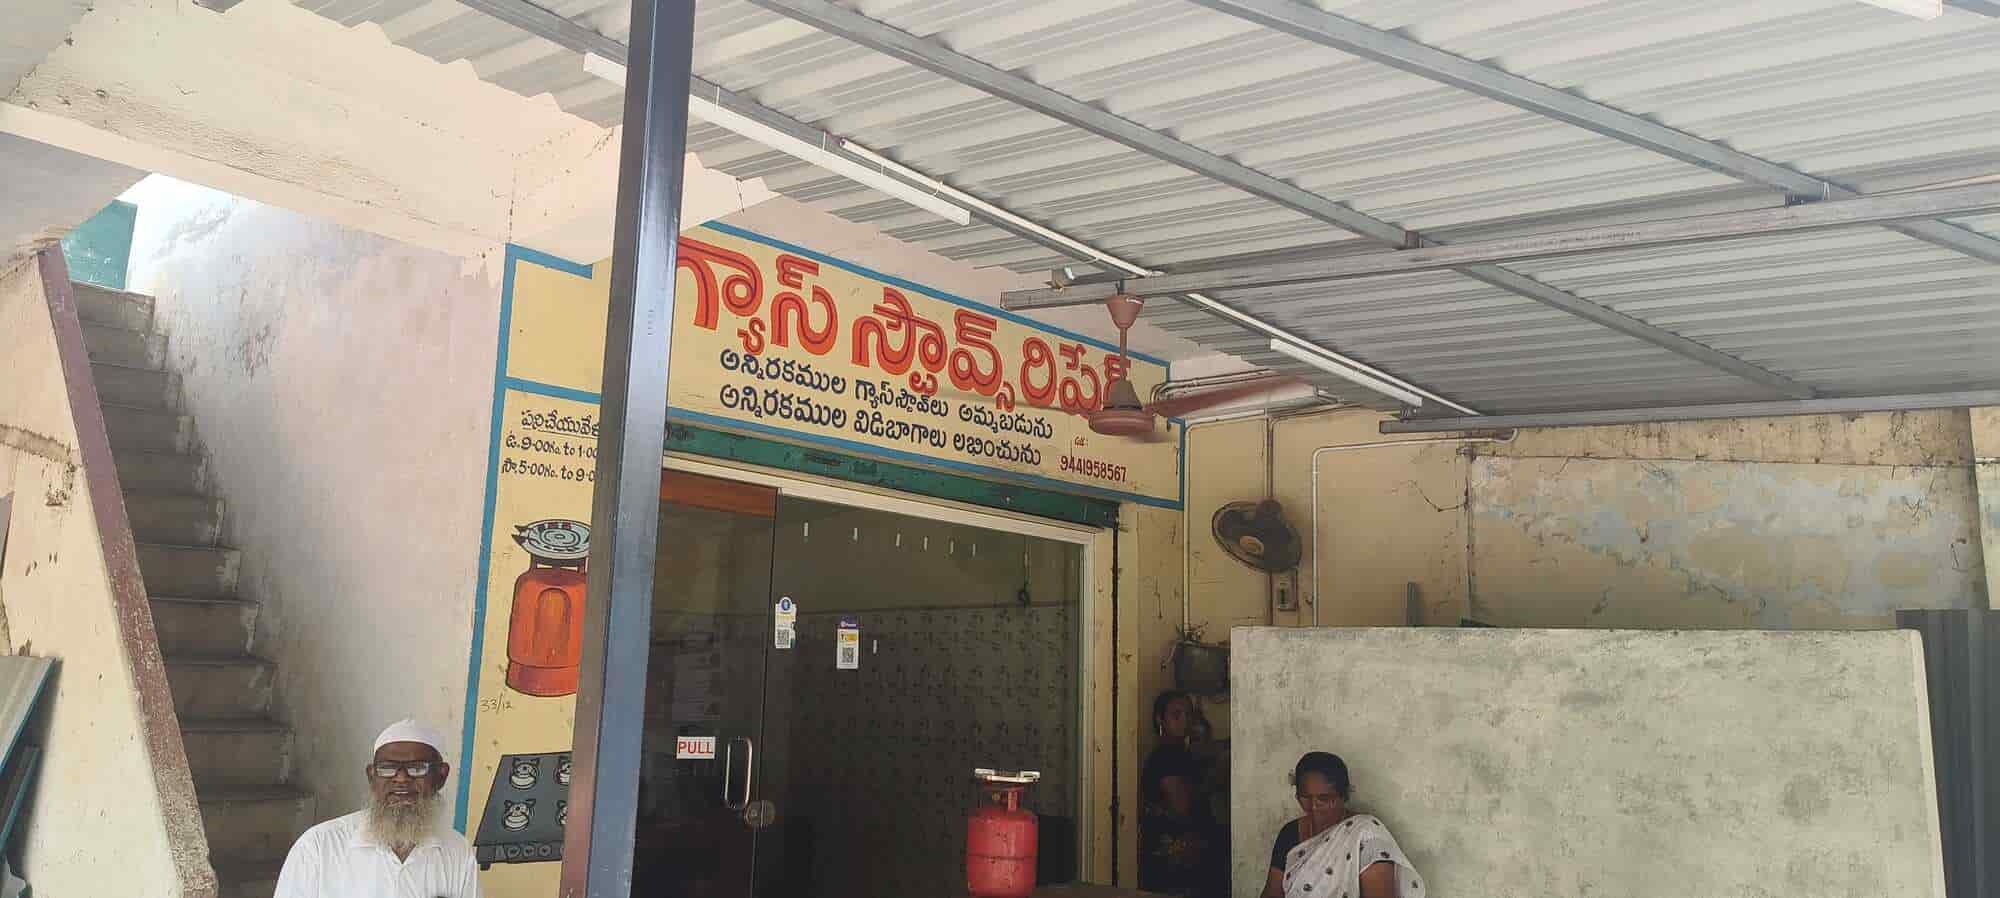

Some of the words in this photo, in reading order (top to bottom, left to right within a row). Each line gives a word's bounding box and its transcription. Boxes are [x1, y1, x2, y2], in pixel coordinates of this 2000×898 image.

[563, 442, 576, 456] to
[560, 465, 574, 480] to
[1060, 455, 1127, 482] 9441958567
[678, 741, 714, 754] PULL
